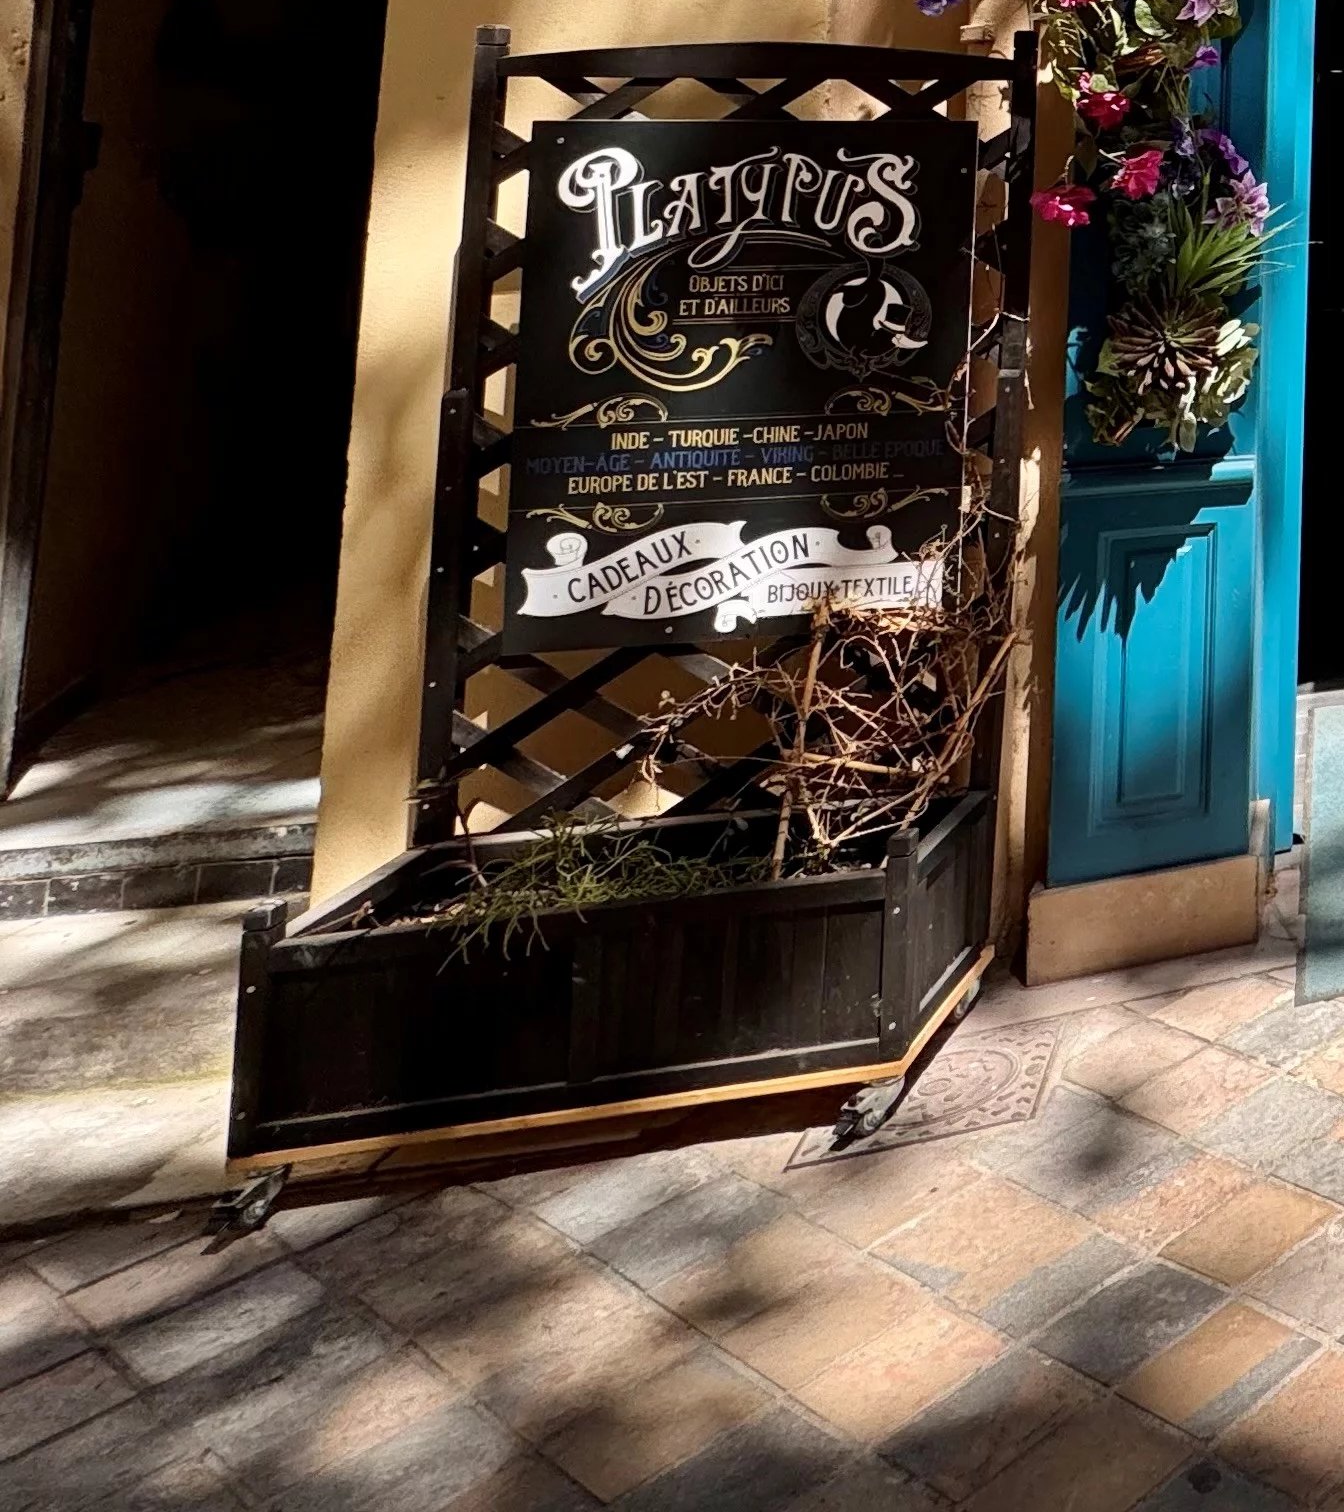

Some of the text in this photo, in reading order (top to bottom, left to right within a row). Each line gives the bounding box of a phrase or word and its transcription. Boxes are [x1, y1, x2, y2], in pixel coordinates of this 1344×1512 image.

[558, 146, 918, 300] PLATYPUS
[688, 273, 785, 292] OBJETS D'ICI
[679, 296, 791, 316] ET D'AILLEURS
[610, 431, 650, 450] INDE
[668, 428, 740, 448] TURQUIE
[760, 444, 814, 464] VIKING
[832, 441, 881, 461] BELLE
[568, 462, 890, 495] EUROPE DE L'EST FRANCE COLOMBIE
[566, 530, 693, 603] CADEAUX
[643, 532, 812, 616] DÉCORATION
[767, 576, 916, 604] BIJOUX TEXTILE
